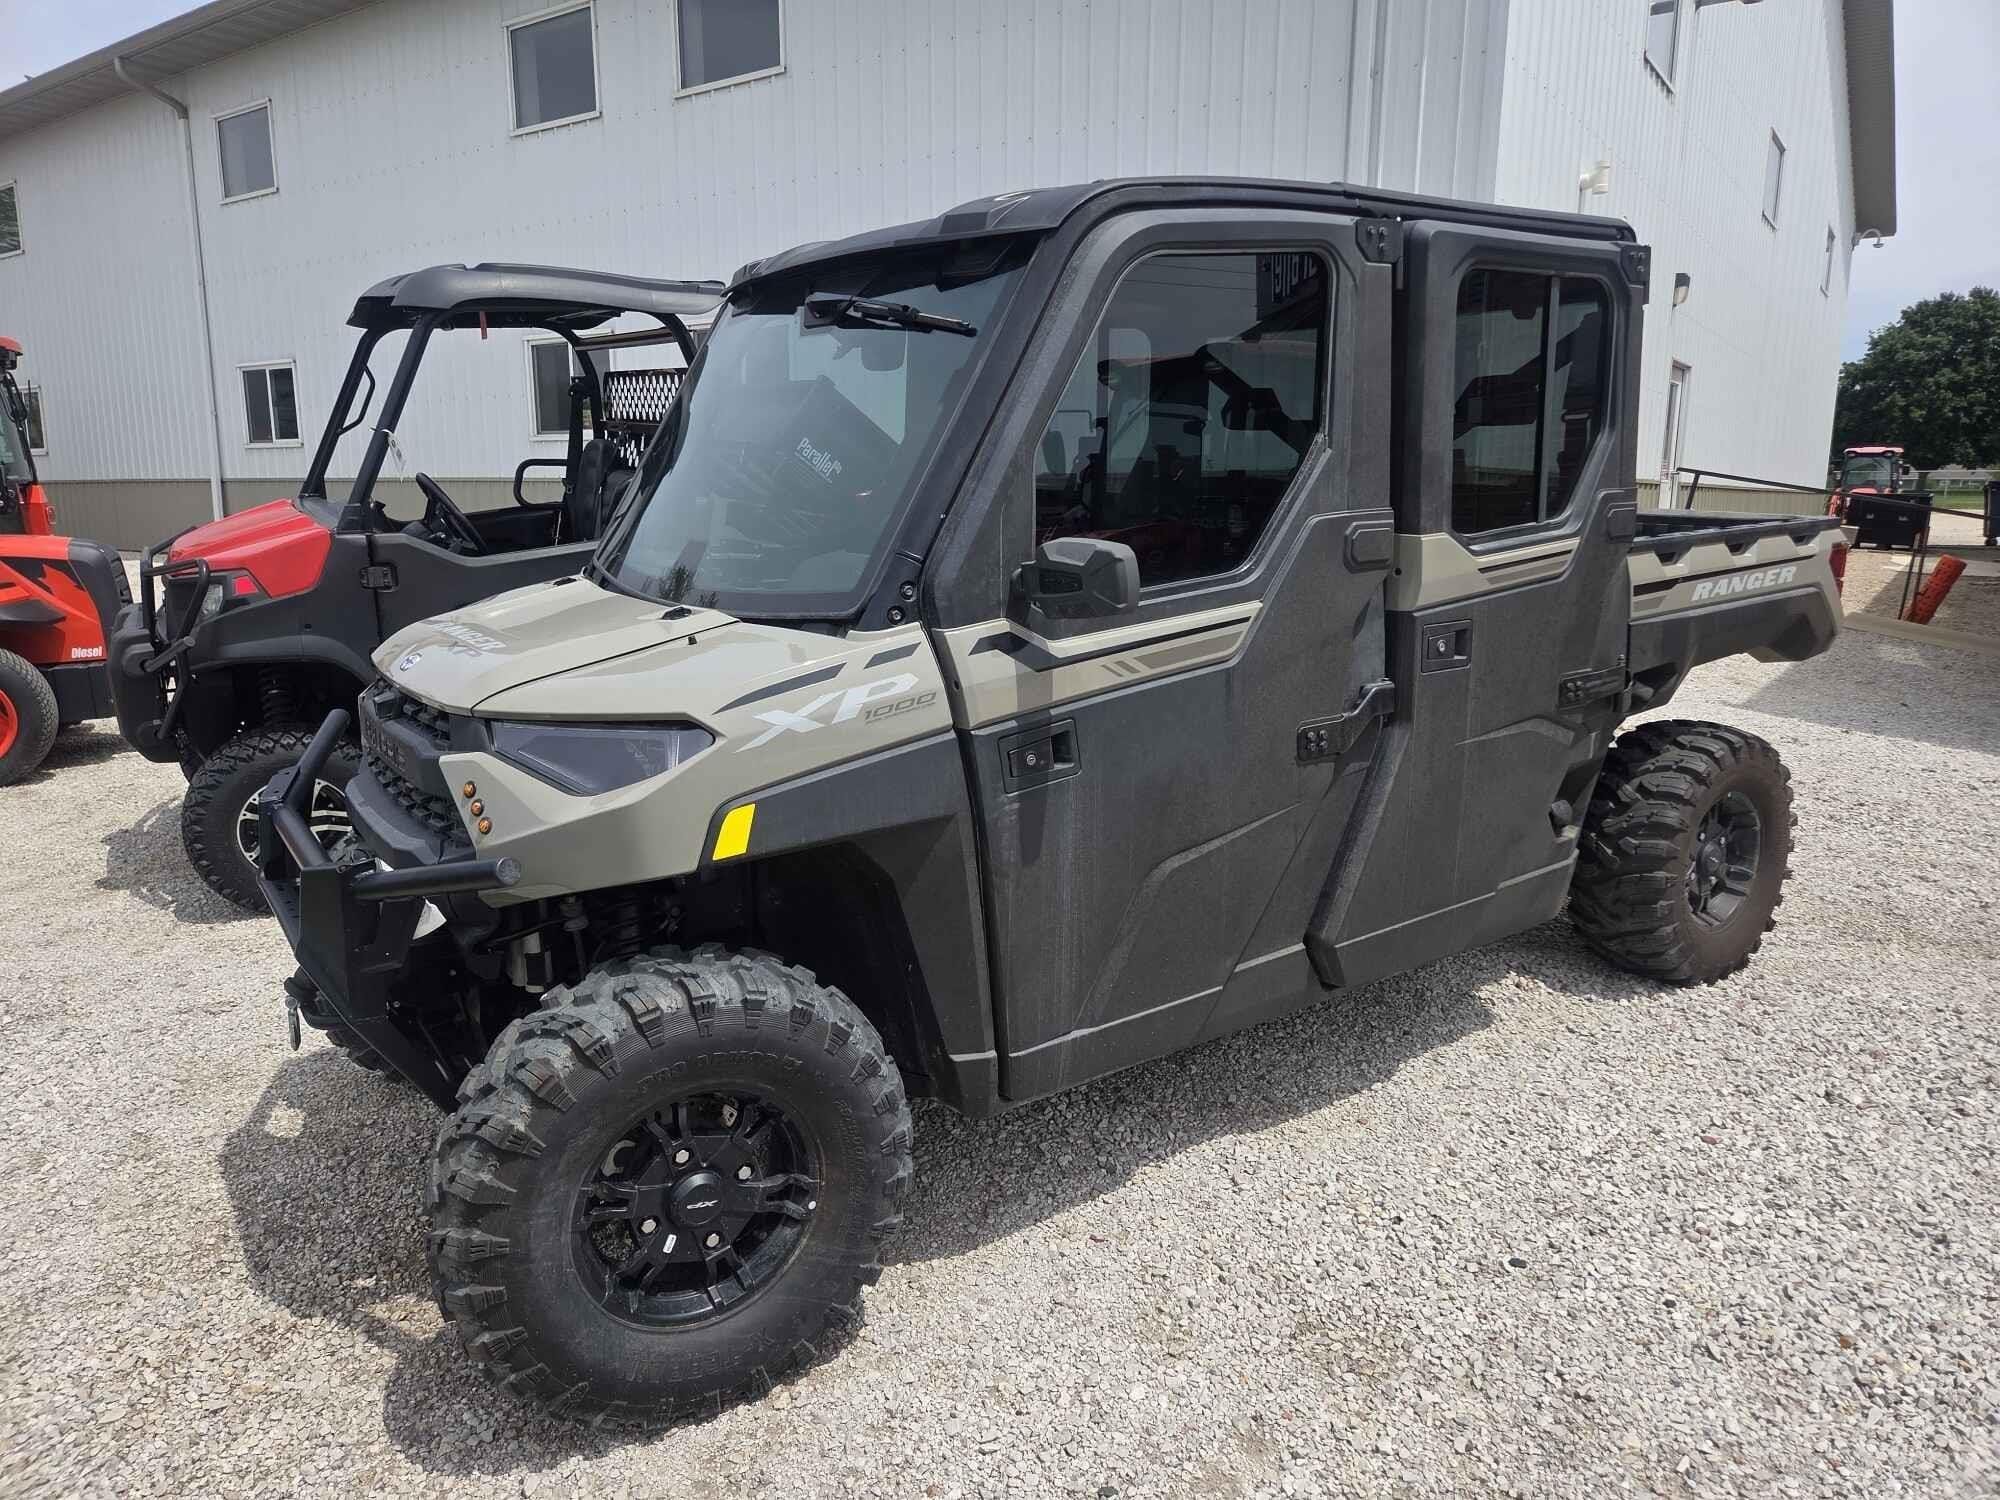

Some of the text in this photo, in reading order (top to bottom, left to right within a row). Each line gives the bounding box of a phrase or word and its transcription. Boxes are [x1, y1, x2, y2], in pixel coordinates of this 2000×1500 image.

[1691, 566, 1797, 601] RANGER
[71, 645, 103, 659] Diesel
[741, 672, 920, 750] XP
[864, 691, 937, 721] 1000
